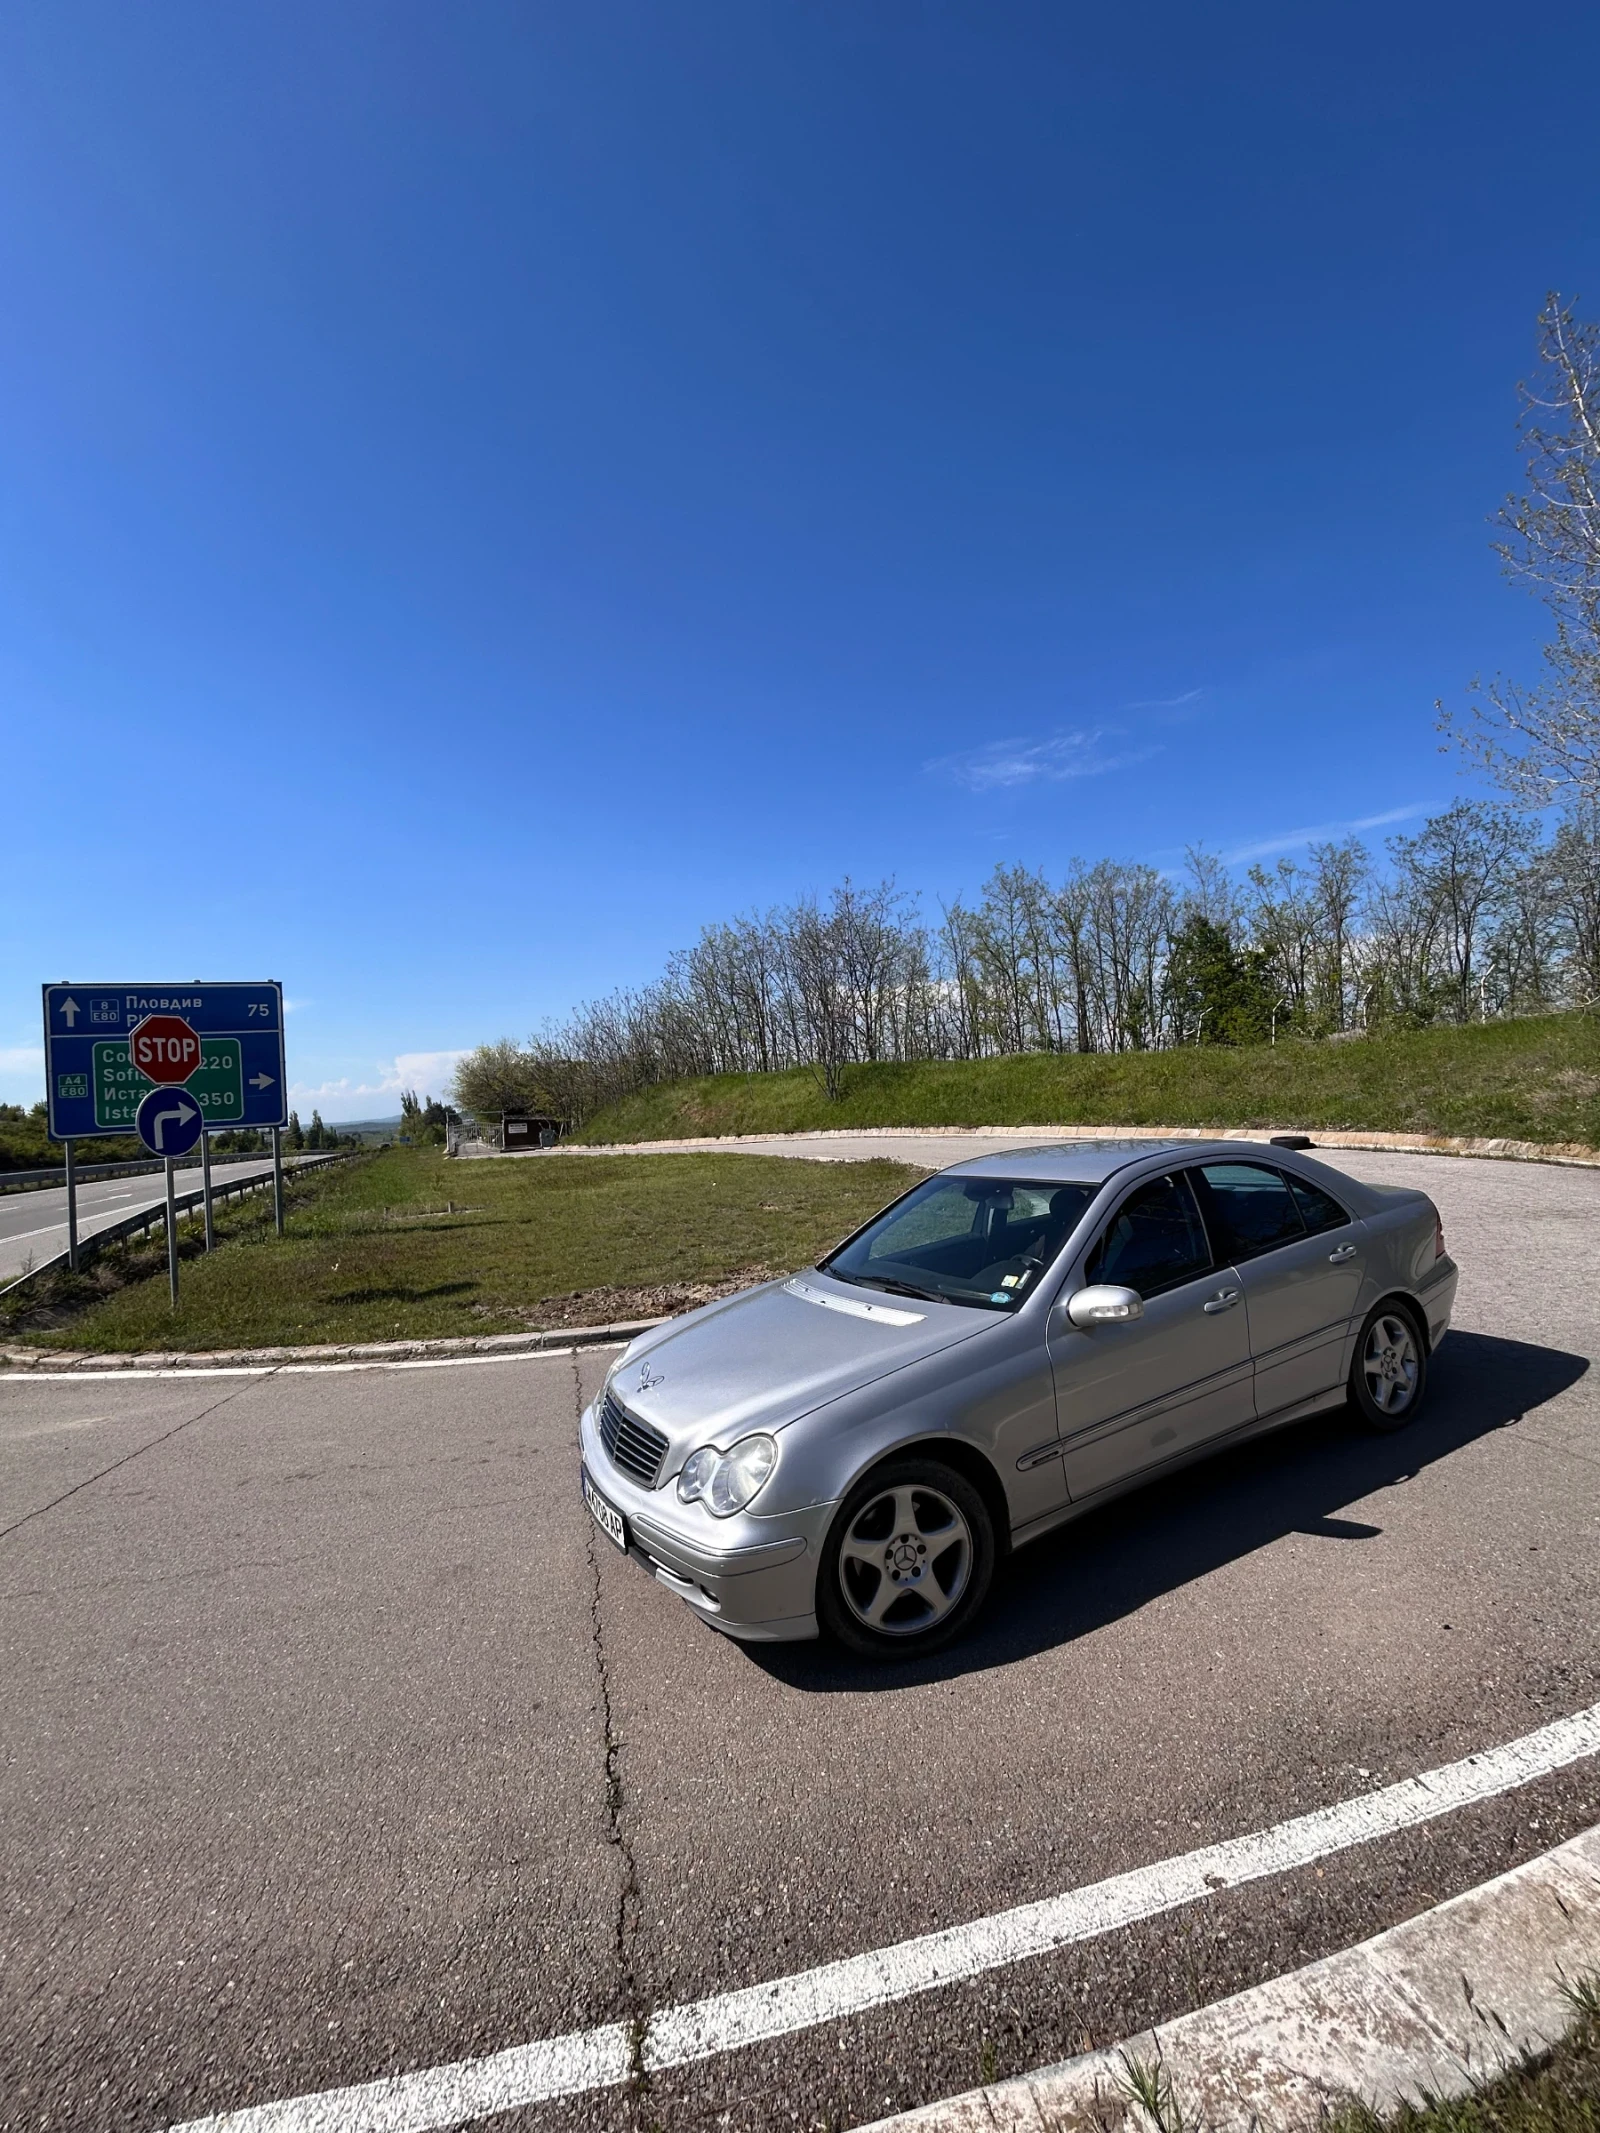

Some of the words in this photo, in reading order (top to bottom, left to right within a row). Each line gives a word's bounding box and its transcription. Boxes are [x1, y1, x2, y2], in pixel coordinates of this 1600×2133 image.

[101, 1001, 109, 1010] 8
[126, 996, 202, 1010] Пловдив
[93, 1012, 117, 1021] E80
[248, 1004, 270, 1017] 75
[138, 1036, 196, 1063] STOP
[199, 1056, 233, 1069] 220
[65, 1076, 82, 1085] A4
[61, 1087, 86, 1096] E80
[199, 1092, 235, 1106] 350
